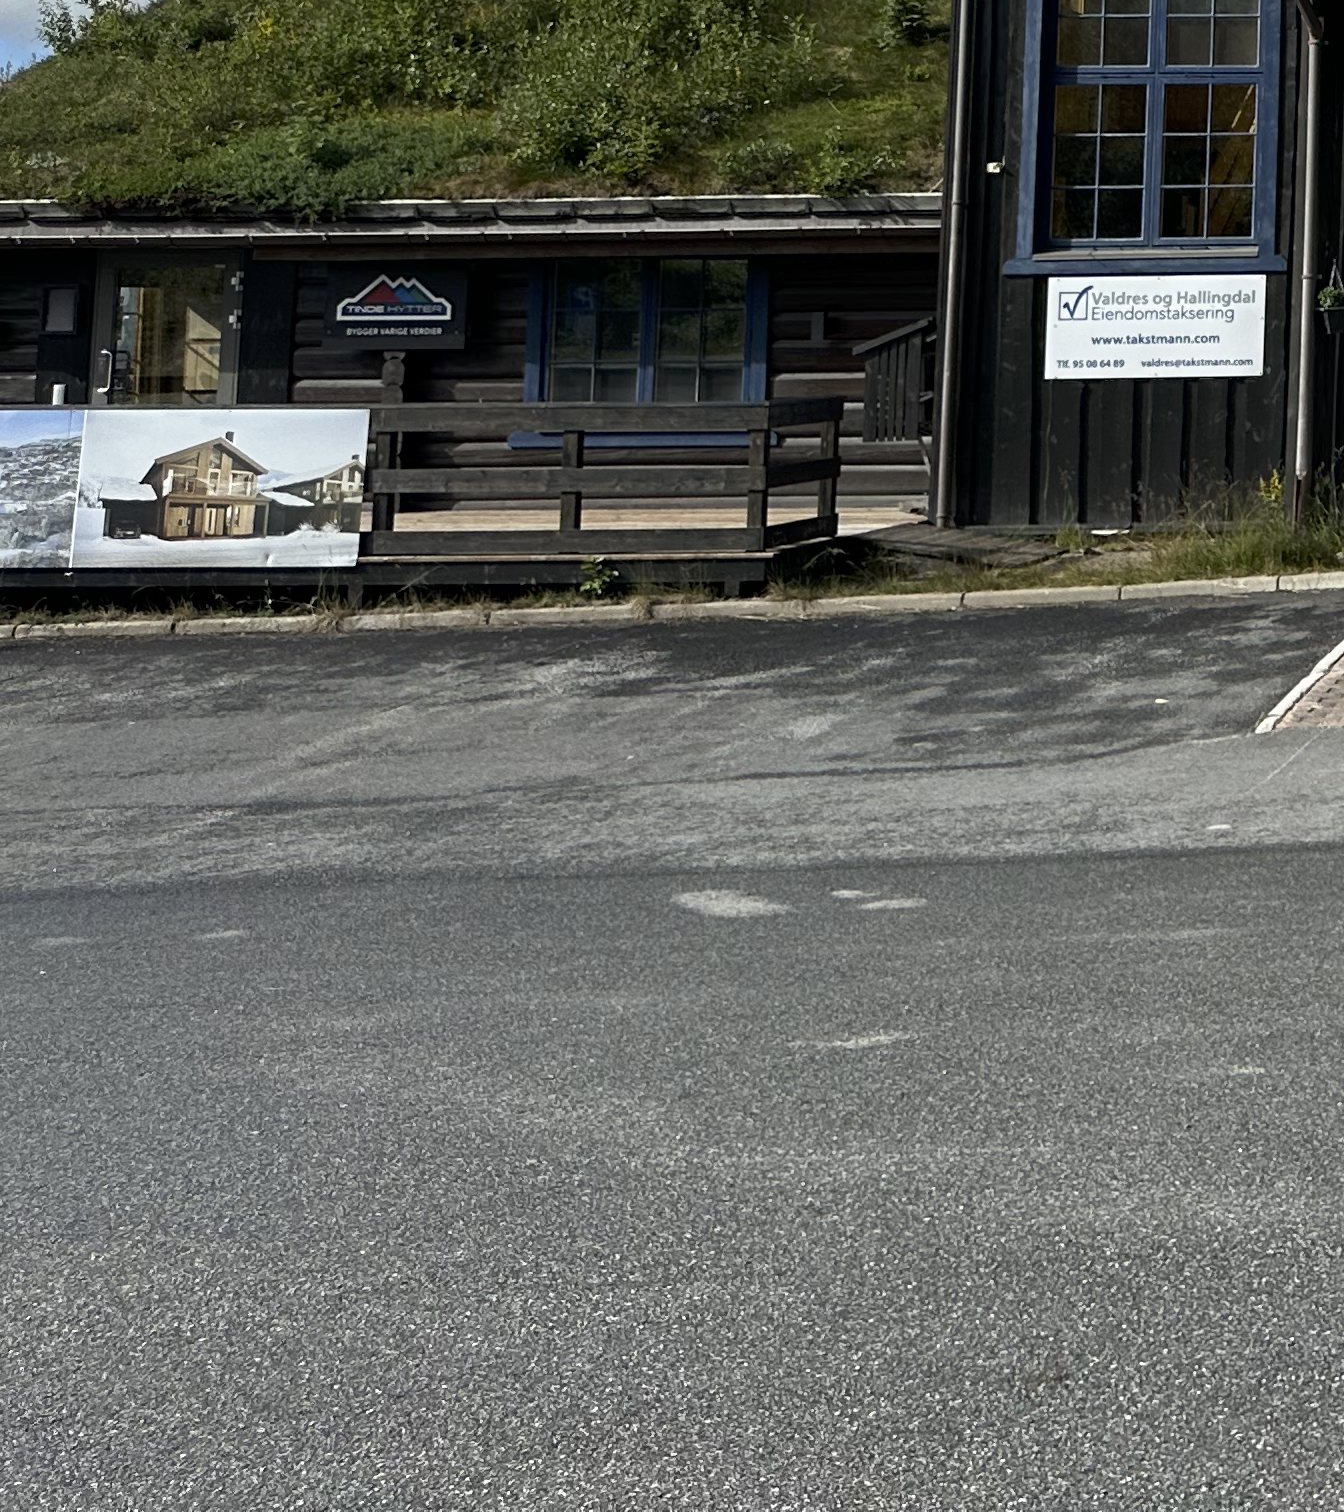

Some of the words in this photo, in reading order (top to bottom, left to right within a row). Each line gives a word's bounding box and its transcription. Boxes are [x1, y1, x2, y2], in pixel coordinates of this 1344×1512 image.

[1091, 292, 1149, 306] Valdres
[1153, 294, 1172, 308] og
[1177, 290, 1256, 307] Hallingdal
[346, 305, 385, 313] TINDE
[387, 305, 443, 313] HYTTER
[1091, 306, 1235, 323] Eiendomstaksering
[346, 328, 379, 336] BYGGER
[409, 328, 443, 336] VERDIER
[1091, 333, 1220, 345] www.takstmann.com
[1057, 359, 1070, 369] Tlf.
[1072, 359, 1084, 369] 95
[1085, 359, 1098, 369] 08
[1099, 359, 1111, 368] 64
[1113, 359, 1125, 368] 89
[1140, 357, 1254, 368] valdres@takstmann.com
